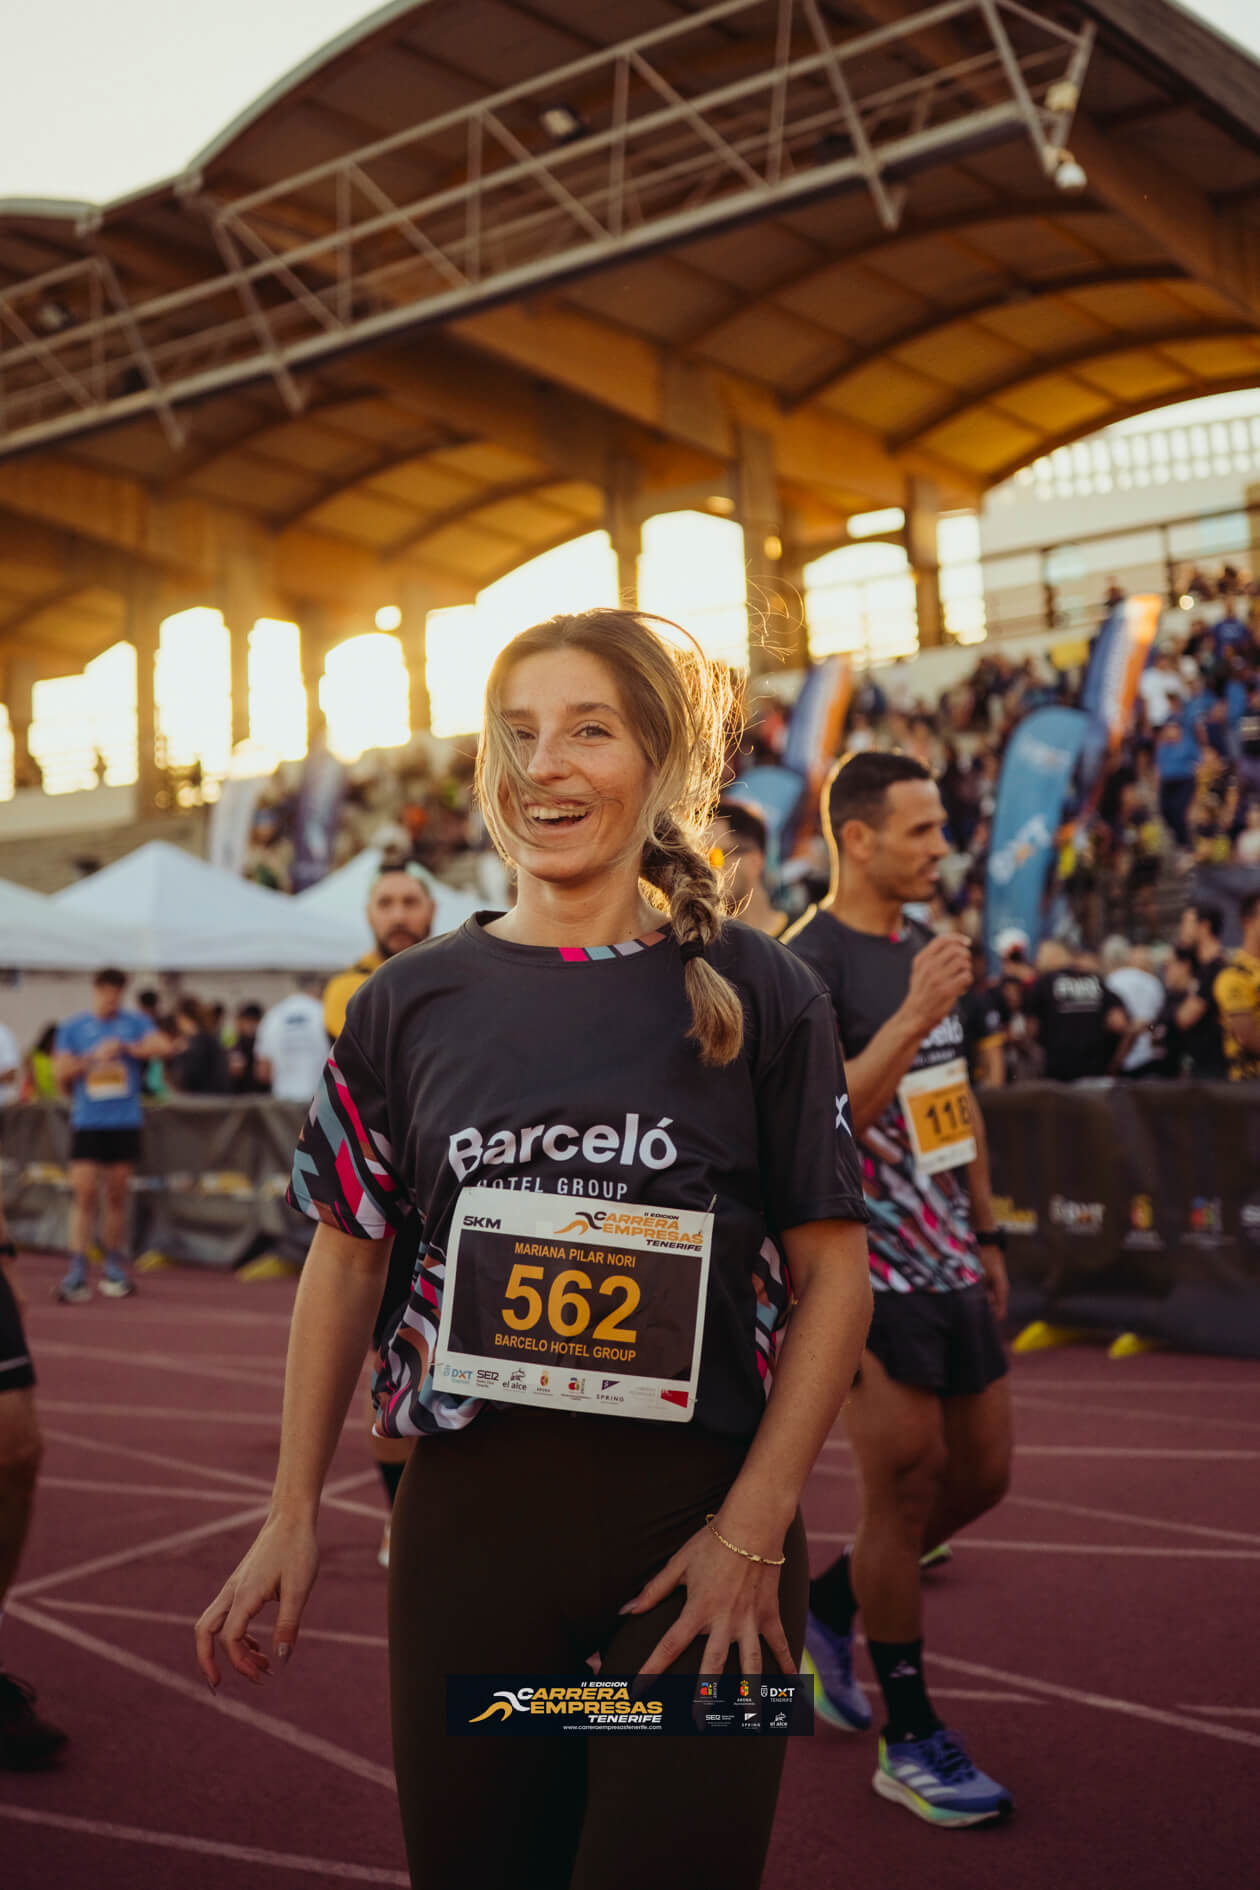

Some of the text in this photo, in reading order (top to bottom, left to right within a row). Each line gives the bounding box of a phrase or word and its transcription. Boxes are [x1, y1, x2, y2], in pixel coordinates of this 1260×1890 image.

[449, 1113, 677, 1182] Barceló
[557, 1178, 628, 1200] GROUP
[463, 1215, 502, 1230] 5KM
[594, 1211, 680, 1230] CARRERA
[602, 1223, 704, 1244] EMPRESAS
[514, 1242, 636, 1268] MARIANA PILAR NORI
[645, 1239, 703, 1252] TENERIFE
[501, 1263, 641, 1343] 562
[494, 1333, 637, 1363] BARCELO HOTEL GROUP
[451, 1368, 473, 1381] DXT
[502, 1380, 510, 1389] el
[596, 1393, 625, 1402] SPRING
